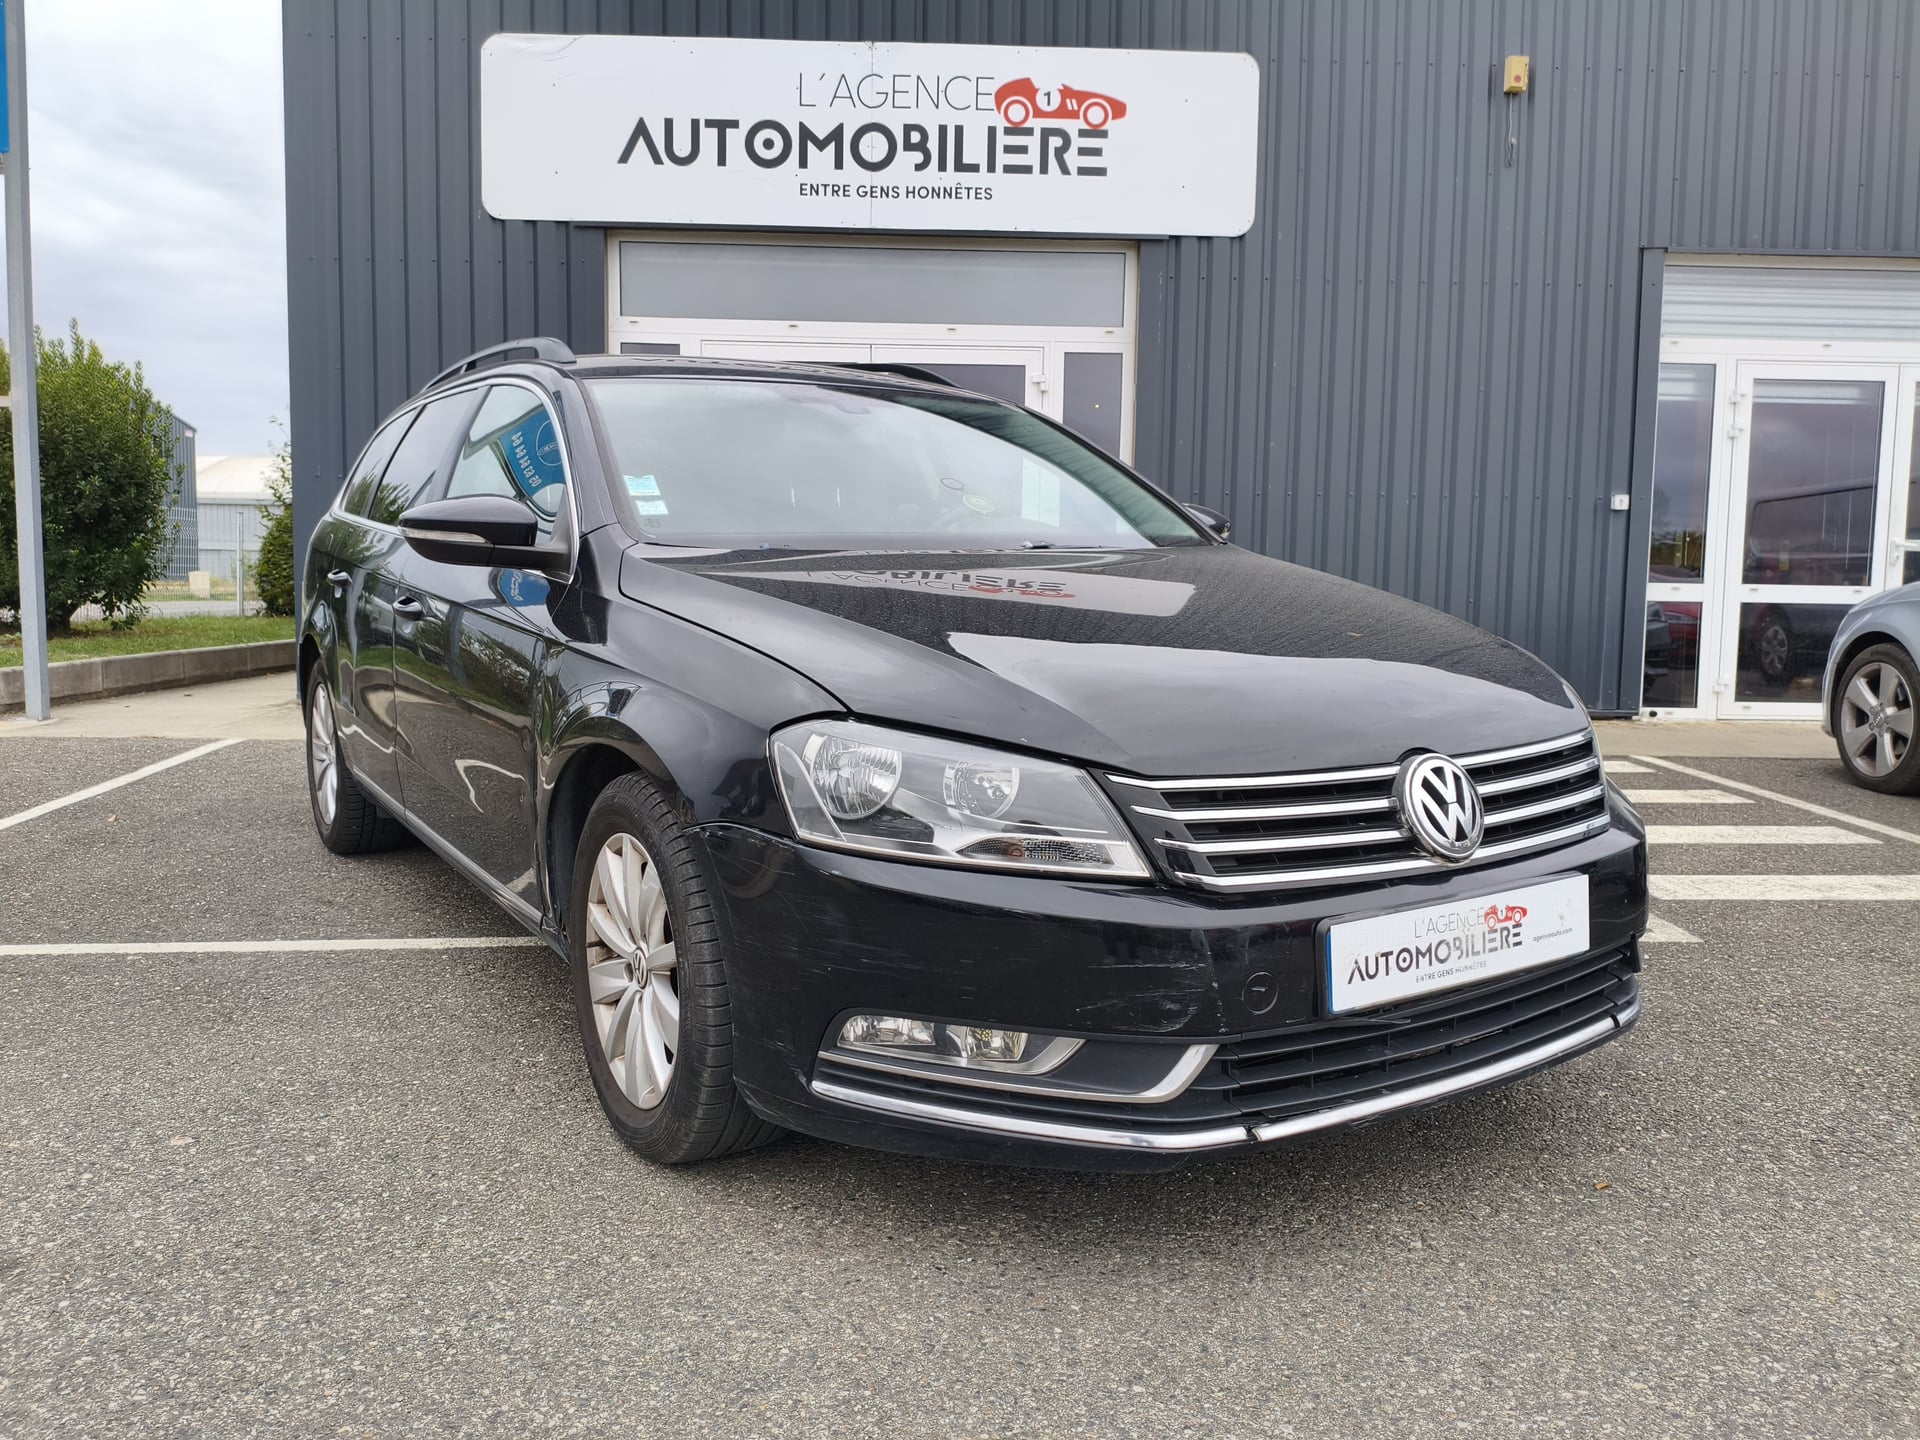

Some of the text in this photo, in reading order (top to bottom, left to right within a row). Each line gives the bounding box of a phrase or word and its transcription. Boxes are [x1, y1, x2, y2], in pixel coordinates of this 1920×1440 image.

[799, 72, 995, 112] L'AGENCE
[1043, 91, 1051, 107] 1
[617, 116, 1109, 177] AUTOMOBILIERE
[799, 181, 993, 200] ENTRE GENS HONNÊTES
[1413, 907, 1485, 939] L'AGENCE
[1347, 922, 1523, 985] AUTOMOBILIERE
[1415, 959, 1488, 984] ENTRE GENS HONNÊTES
